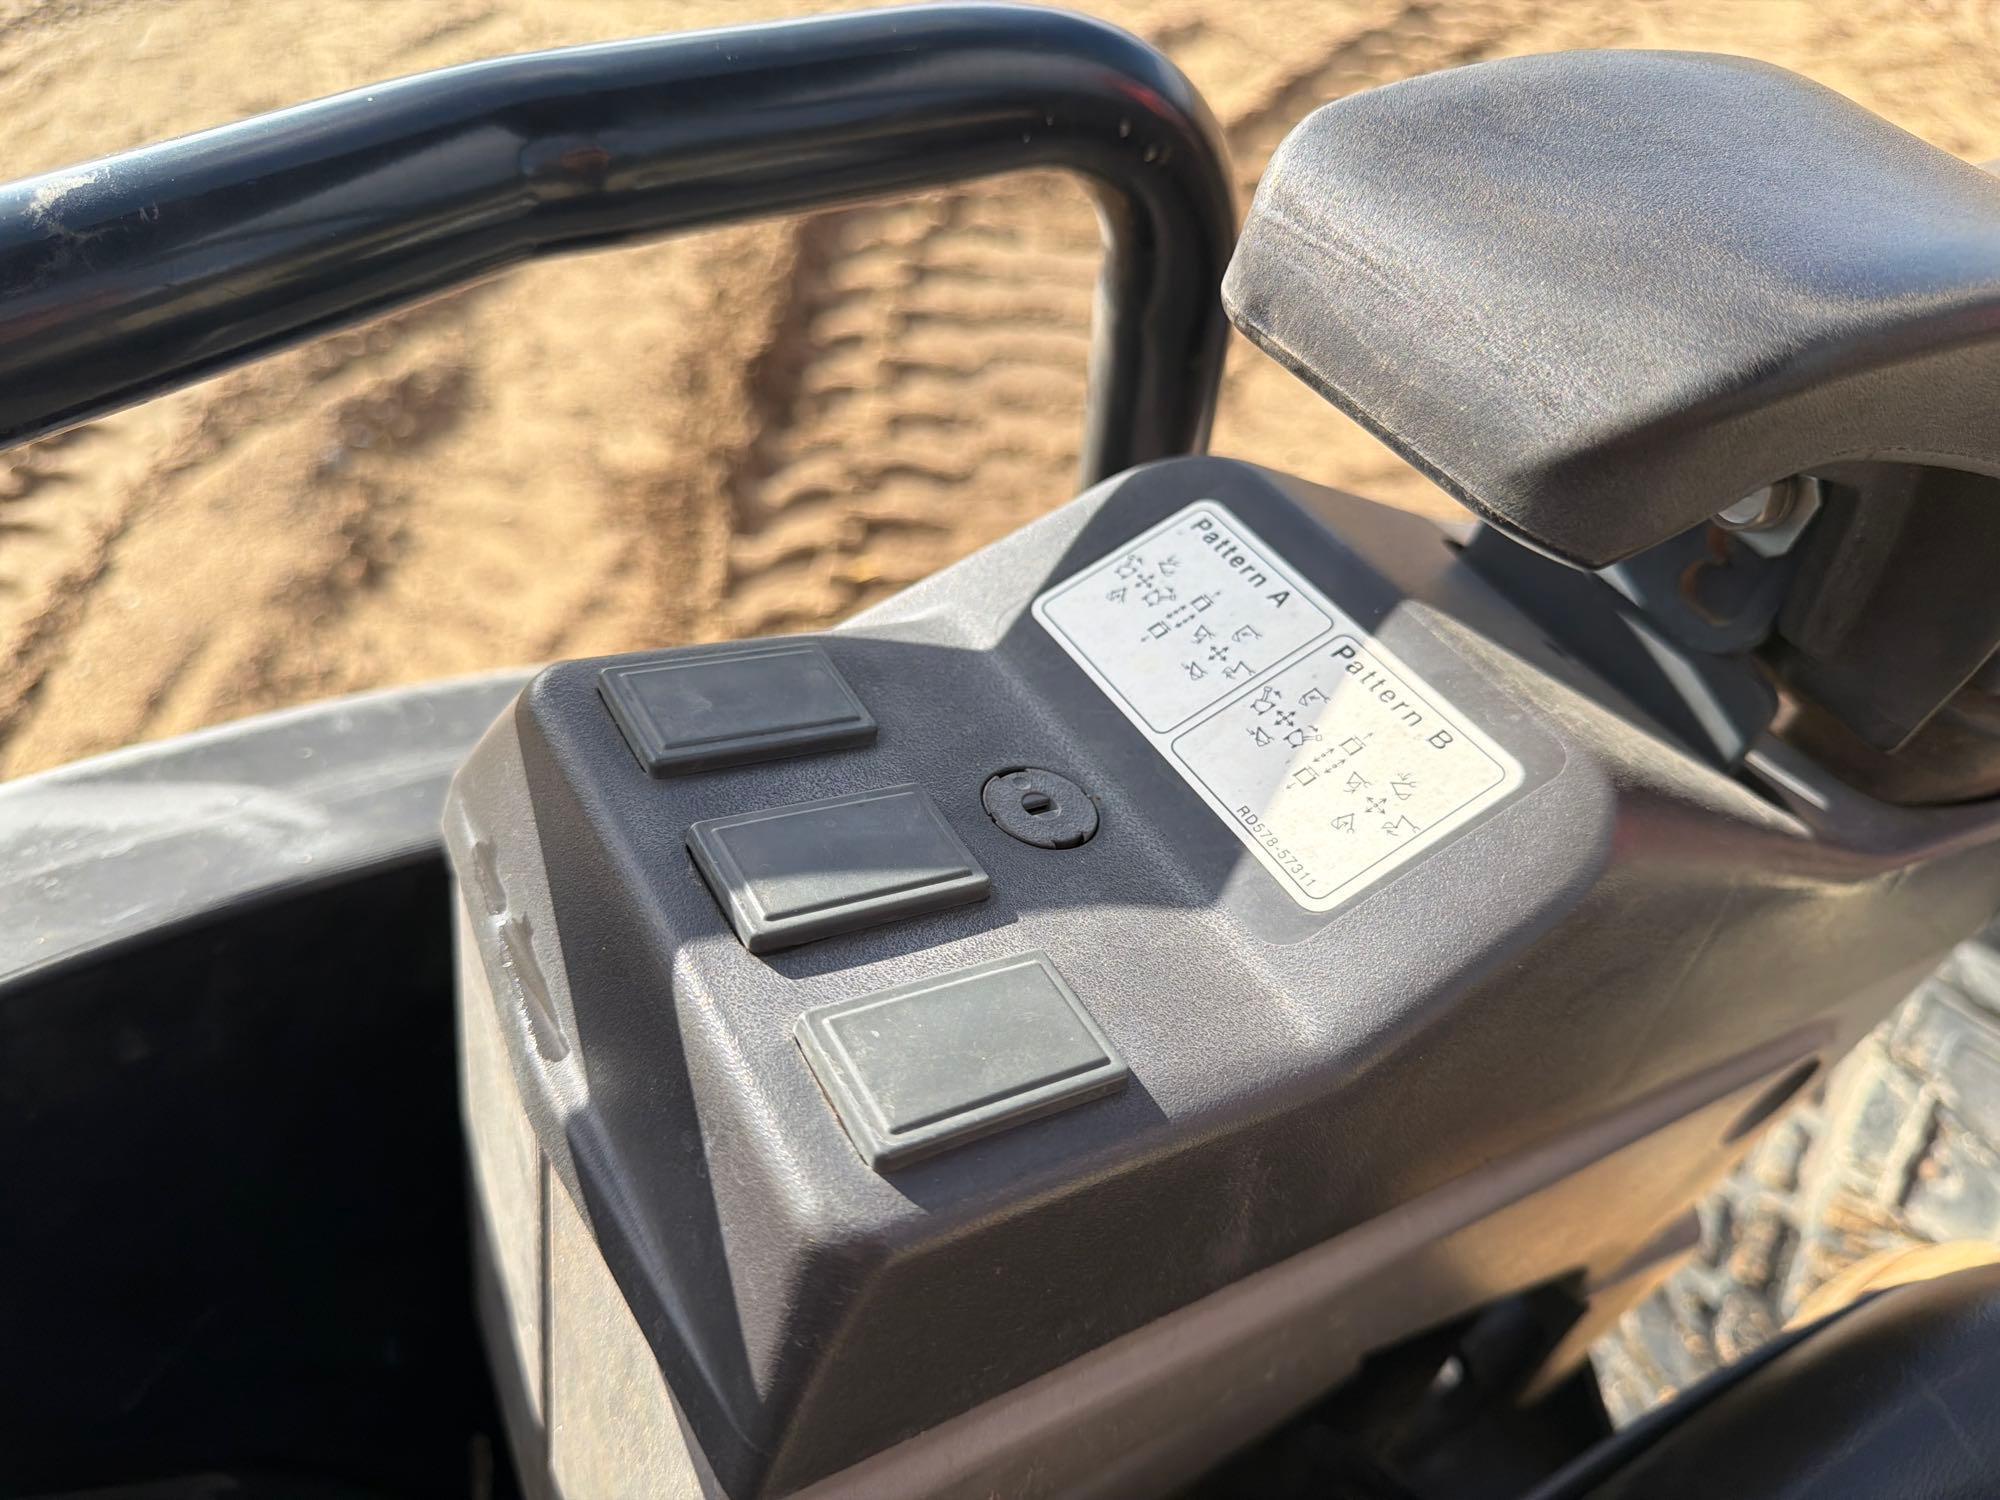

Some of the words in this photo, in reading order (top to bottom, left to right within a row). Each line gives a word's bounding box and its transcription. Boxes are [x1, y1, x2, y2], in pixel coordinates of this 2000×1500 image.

[1190, 517, 1267, 588] Pattern
[1266, 591, 1290, 608] A
[1330, 644, 1423, 727] Pattern
[1428, 729, 1454, 750] B
[1236, 805, 1317, 887] RD578-57311
